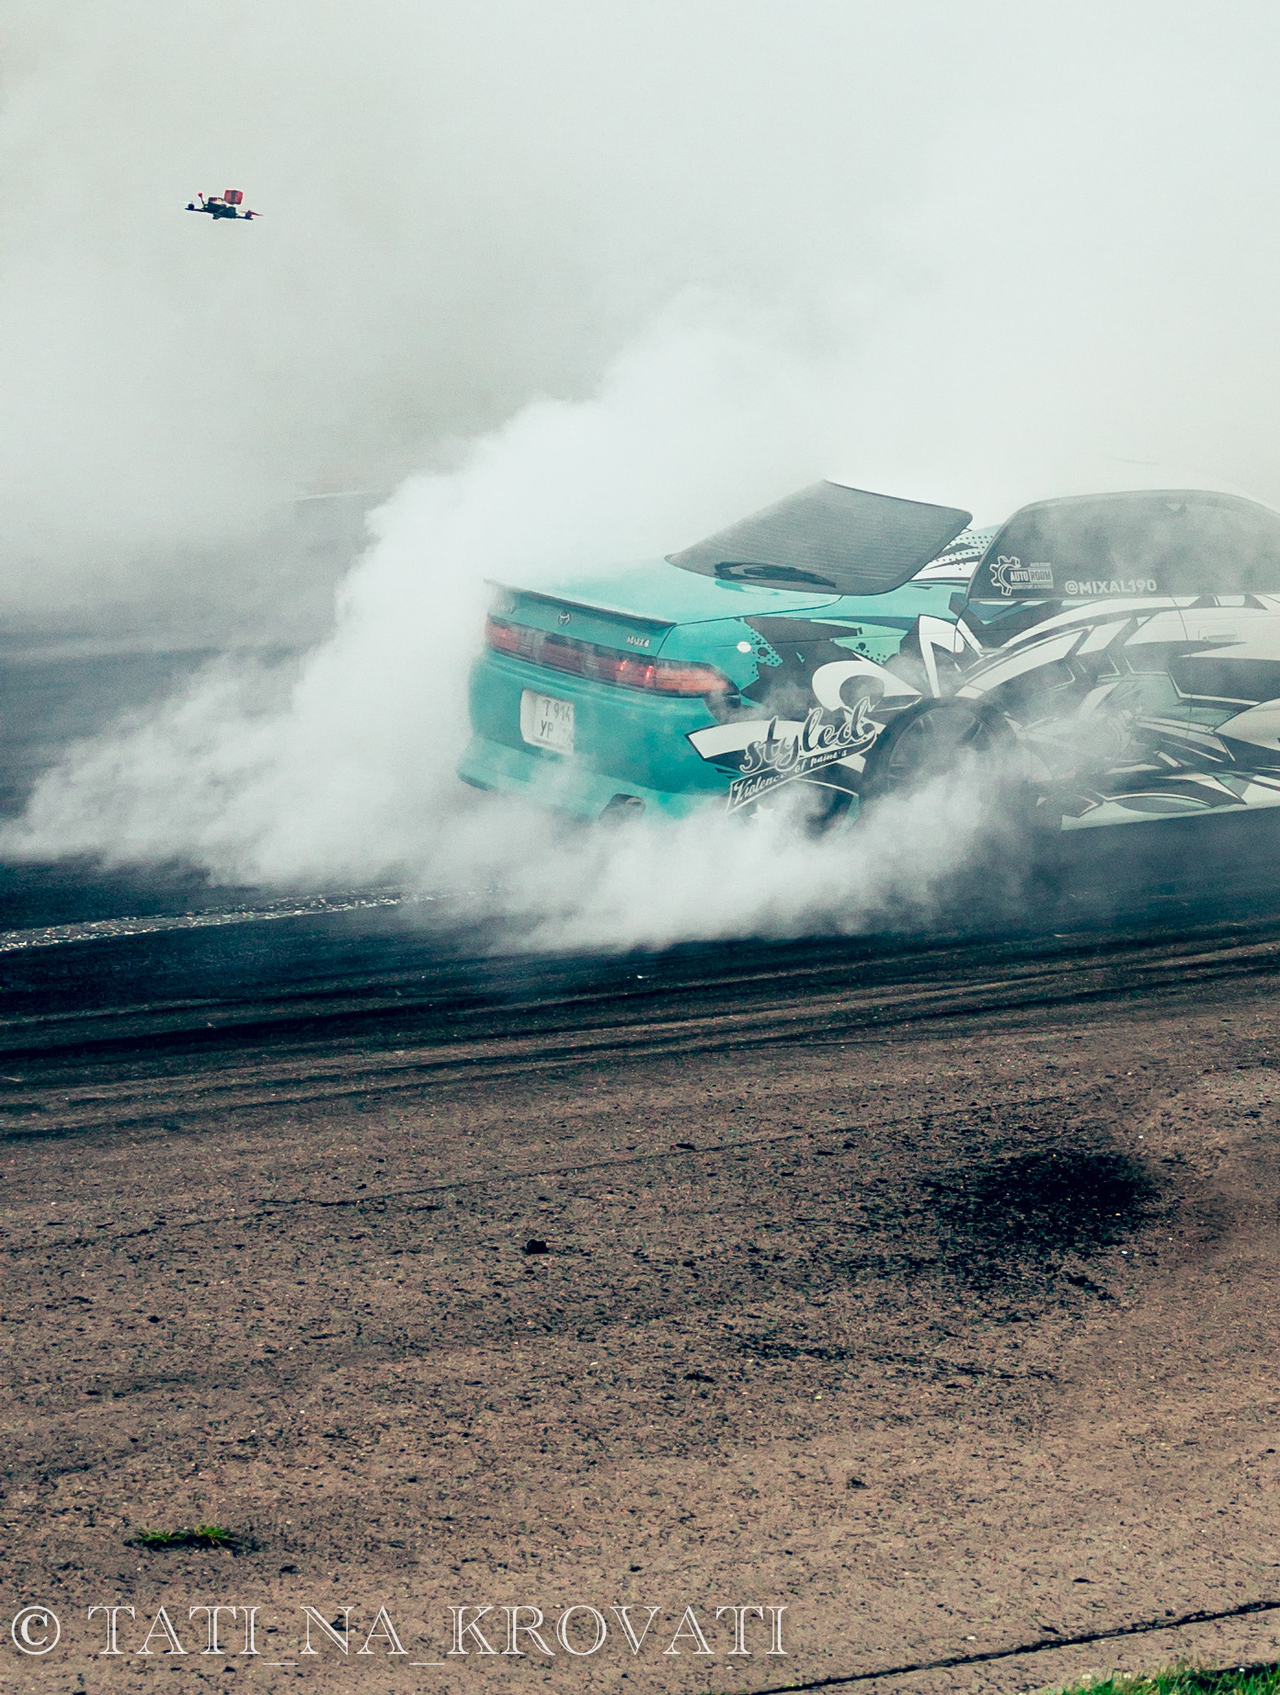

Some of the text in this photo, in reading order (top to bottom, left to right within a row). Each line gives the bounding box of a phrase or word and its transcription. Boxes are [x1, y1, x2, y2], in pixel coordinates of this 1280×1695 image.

[1010, 569, 1052, 582] AUTO ROOM
[1065, 579, 1158, 595] @MIXAL190
